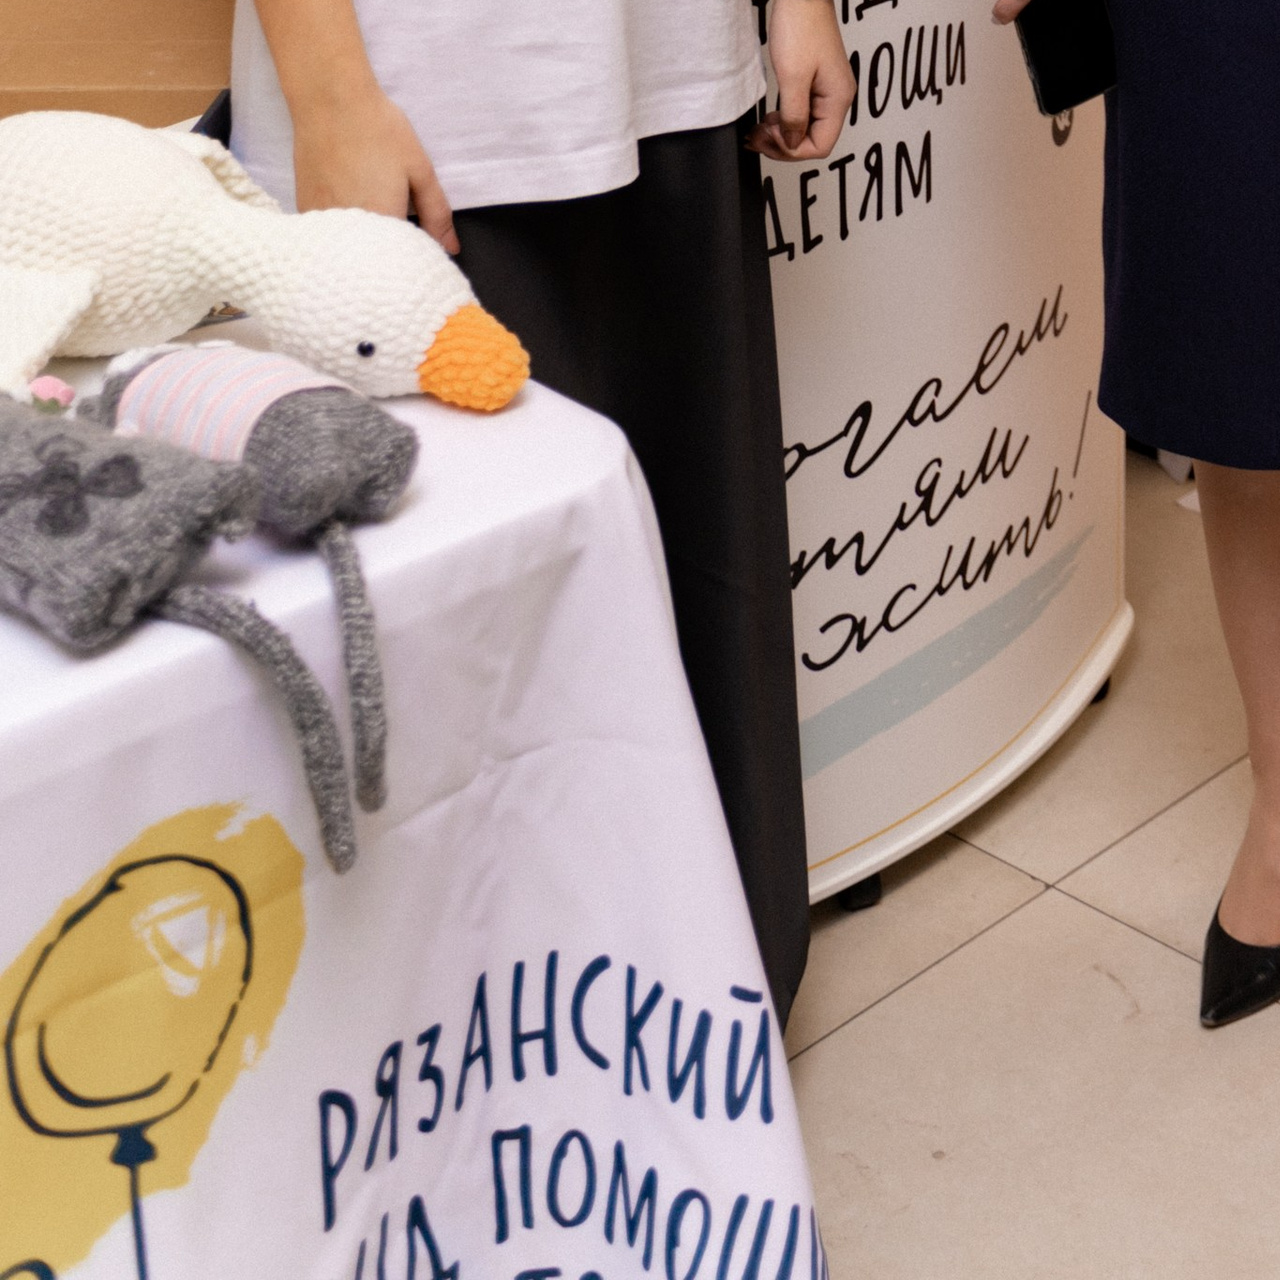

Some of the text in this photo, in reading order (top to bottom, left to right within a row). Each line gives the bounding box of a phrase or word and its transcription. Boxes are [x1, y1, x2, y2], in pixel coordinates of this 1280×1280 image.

[763, 130, 932, 262] ДЕТЯМ
[790, 427, 1030, 590] тям
[802, 390, 1092, 671] жить!
[319, 949, 775, 1232] РЯЗАНСКИЙ
